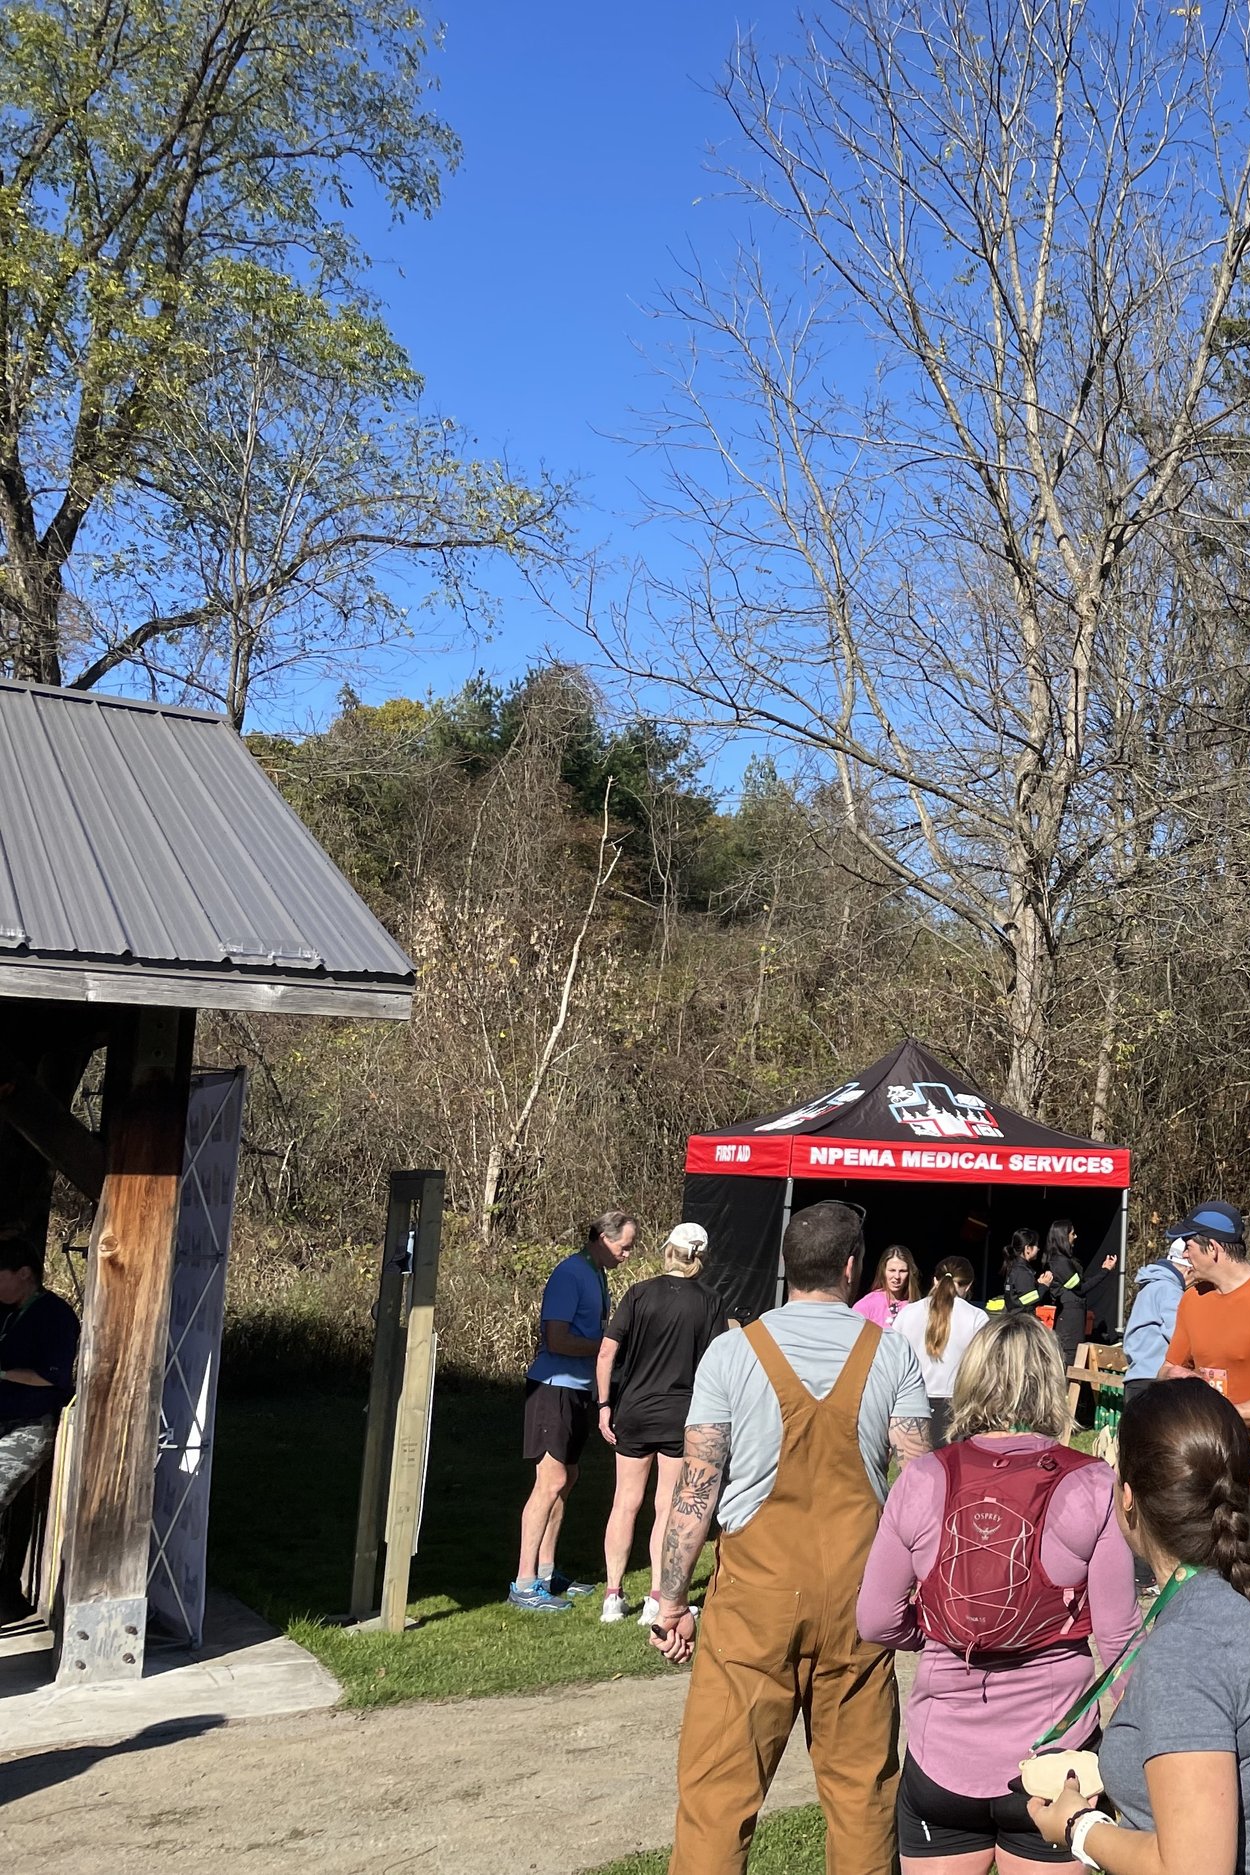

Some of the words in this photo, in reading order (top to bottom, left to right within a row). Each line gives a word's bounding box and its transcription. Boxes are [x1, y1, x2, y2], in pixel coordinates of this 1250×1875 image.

[715, 1145, 736, 1162] FIRST
[736, 1145, 751, 1163] AID
[810, 1146, 896, 1167] NPEMA
[901, 1151, 1004, 1170] MEDICAL
[1009, 1154, 1114, 1174] SERVICES
[974, 1513, 1002, 1523] OSPREY
